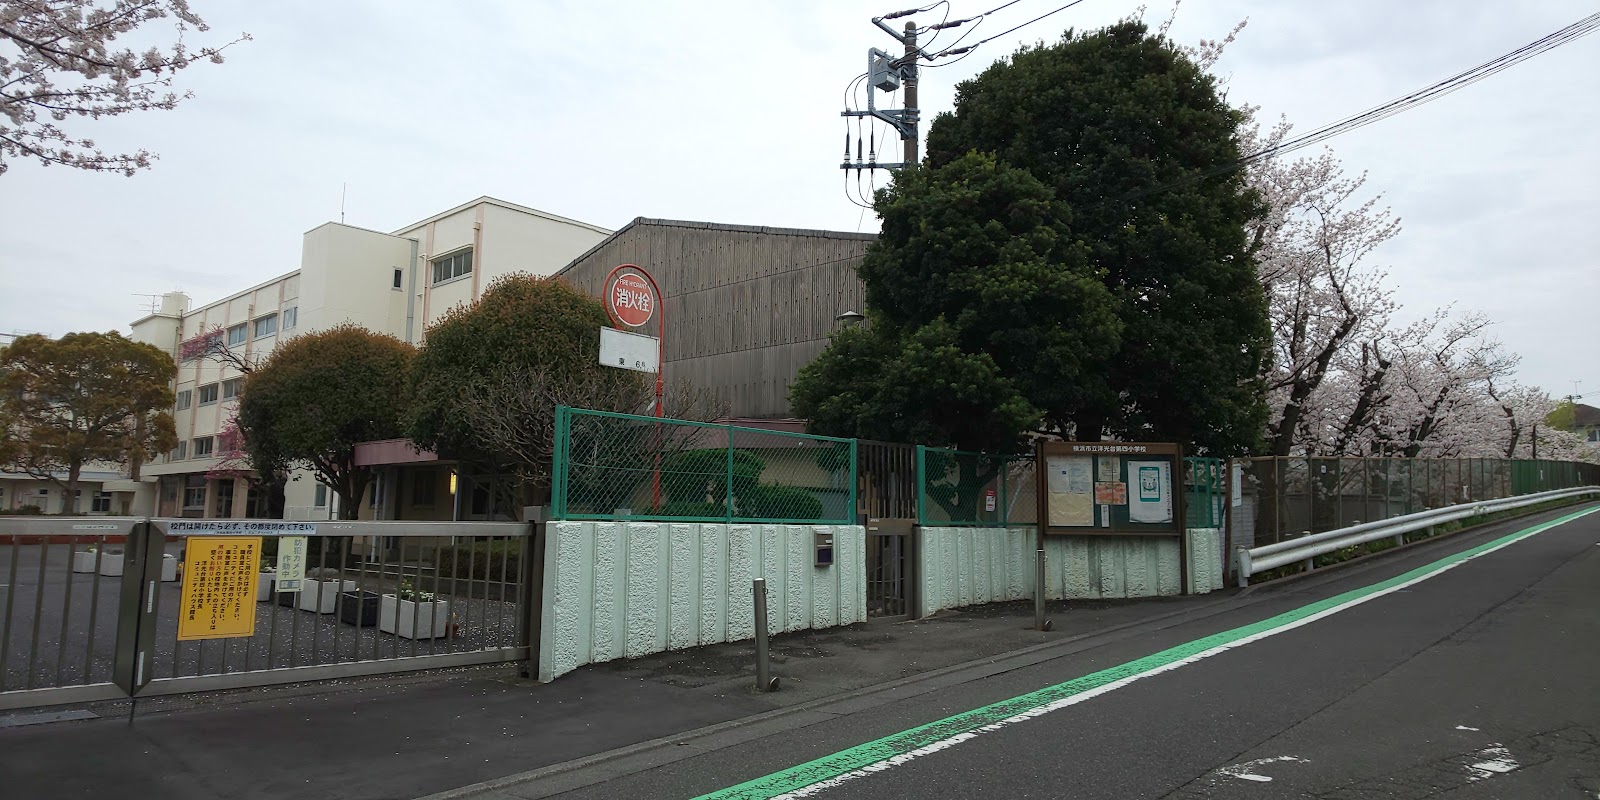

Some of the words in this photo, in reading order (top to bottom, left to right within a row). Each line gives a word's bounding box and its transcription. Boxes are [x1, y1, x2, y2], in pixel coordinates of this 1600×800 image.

[616, 287, 650, 312] 消火栓
[1073, 445, 1147, 453] 横浜市立洋光台第四小学校
[243, 544, 253, 597] 学校にご用の方は必ず
[281, 554, 291, 578] 作動中
[292, 538, 302, 578] 防犯カメラ
[189, 561, 200, 621] コミュニティハウス館長
[197, 560, 207, 610] 洋光台第四小学校長
